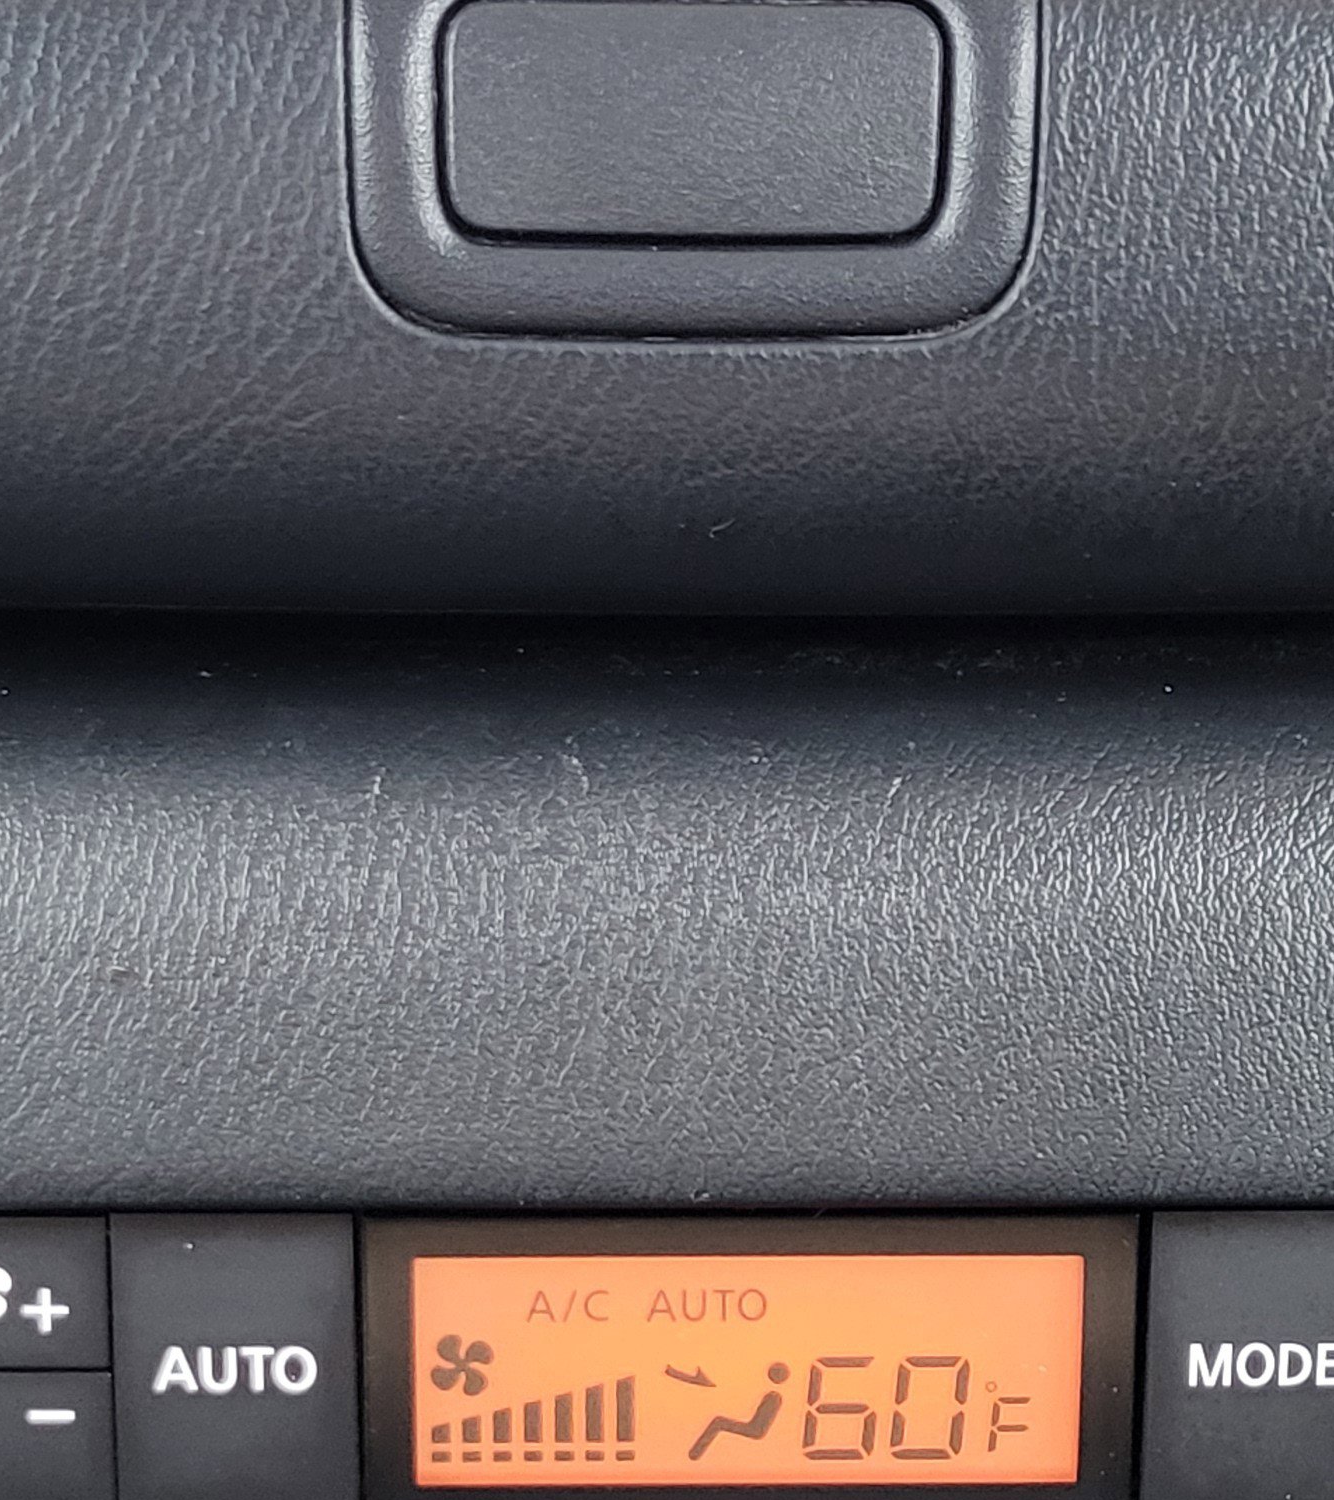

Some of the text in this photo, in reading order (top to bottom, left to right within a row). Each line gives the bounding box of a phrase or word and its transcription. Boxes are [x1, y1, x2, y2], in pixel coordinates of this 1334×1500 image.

[526, 1288, 768, 1323] A/C AUTO
[152, 1345, 318, 1394] AUTO
